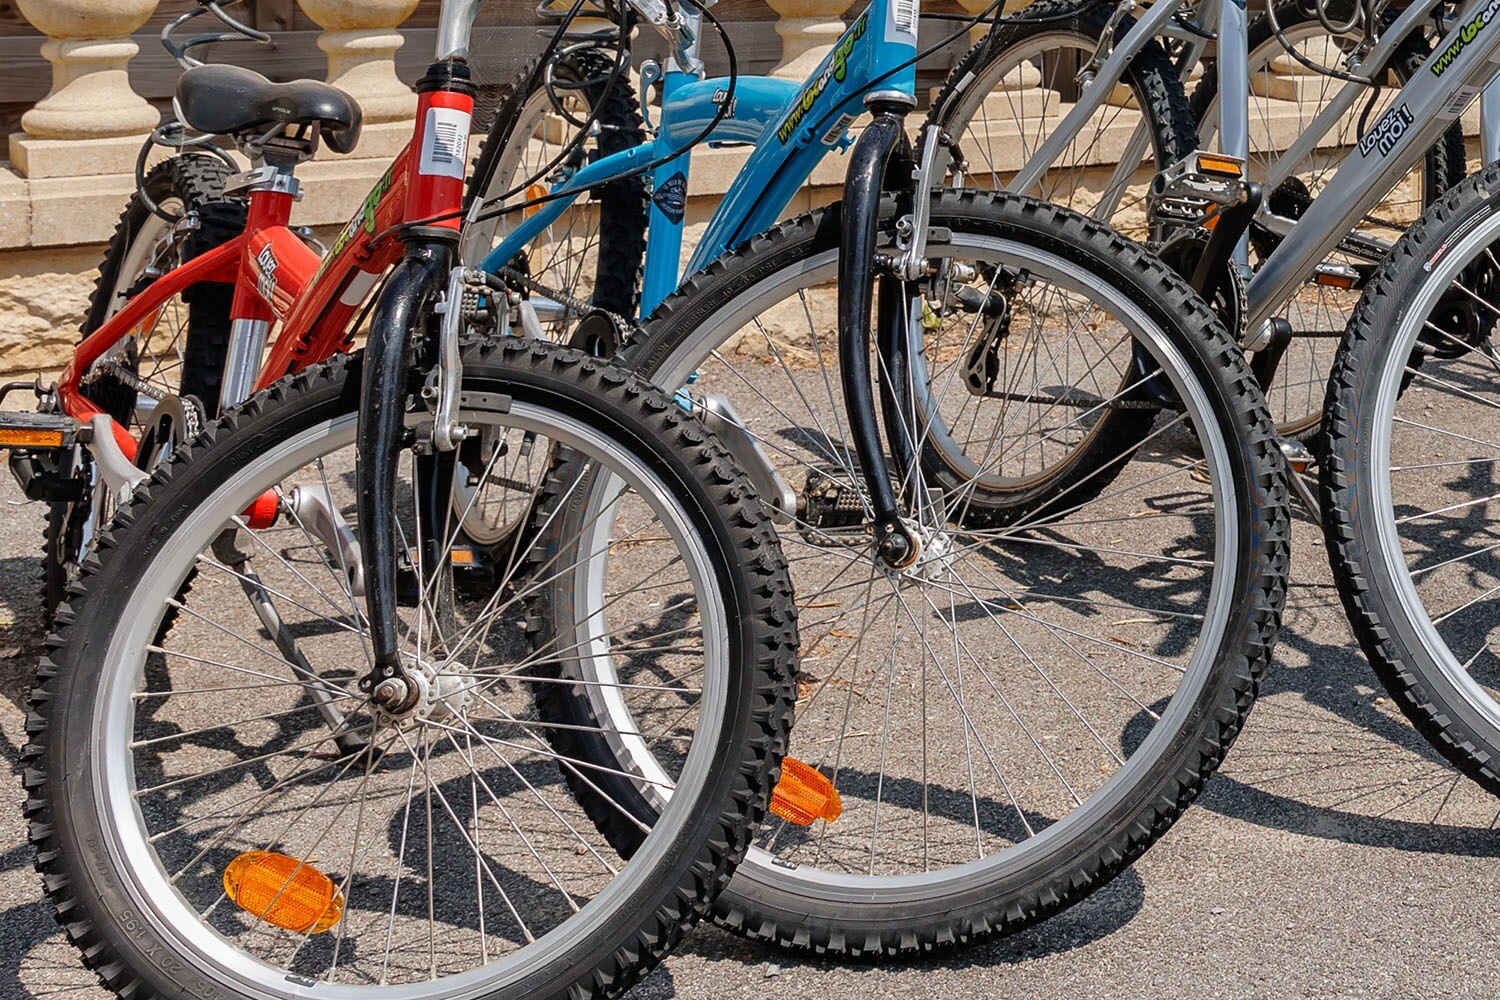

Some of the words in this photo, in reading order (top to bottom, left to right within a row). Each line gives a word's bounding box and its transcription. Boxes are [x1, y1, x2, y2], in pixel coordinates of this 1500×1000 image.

[1359, 109, 1396, 156] Louez
[119, 910, 147, 940] 1.95
[161, 956, 184, 975] 20
